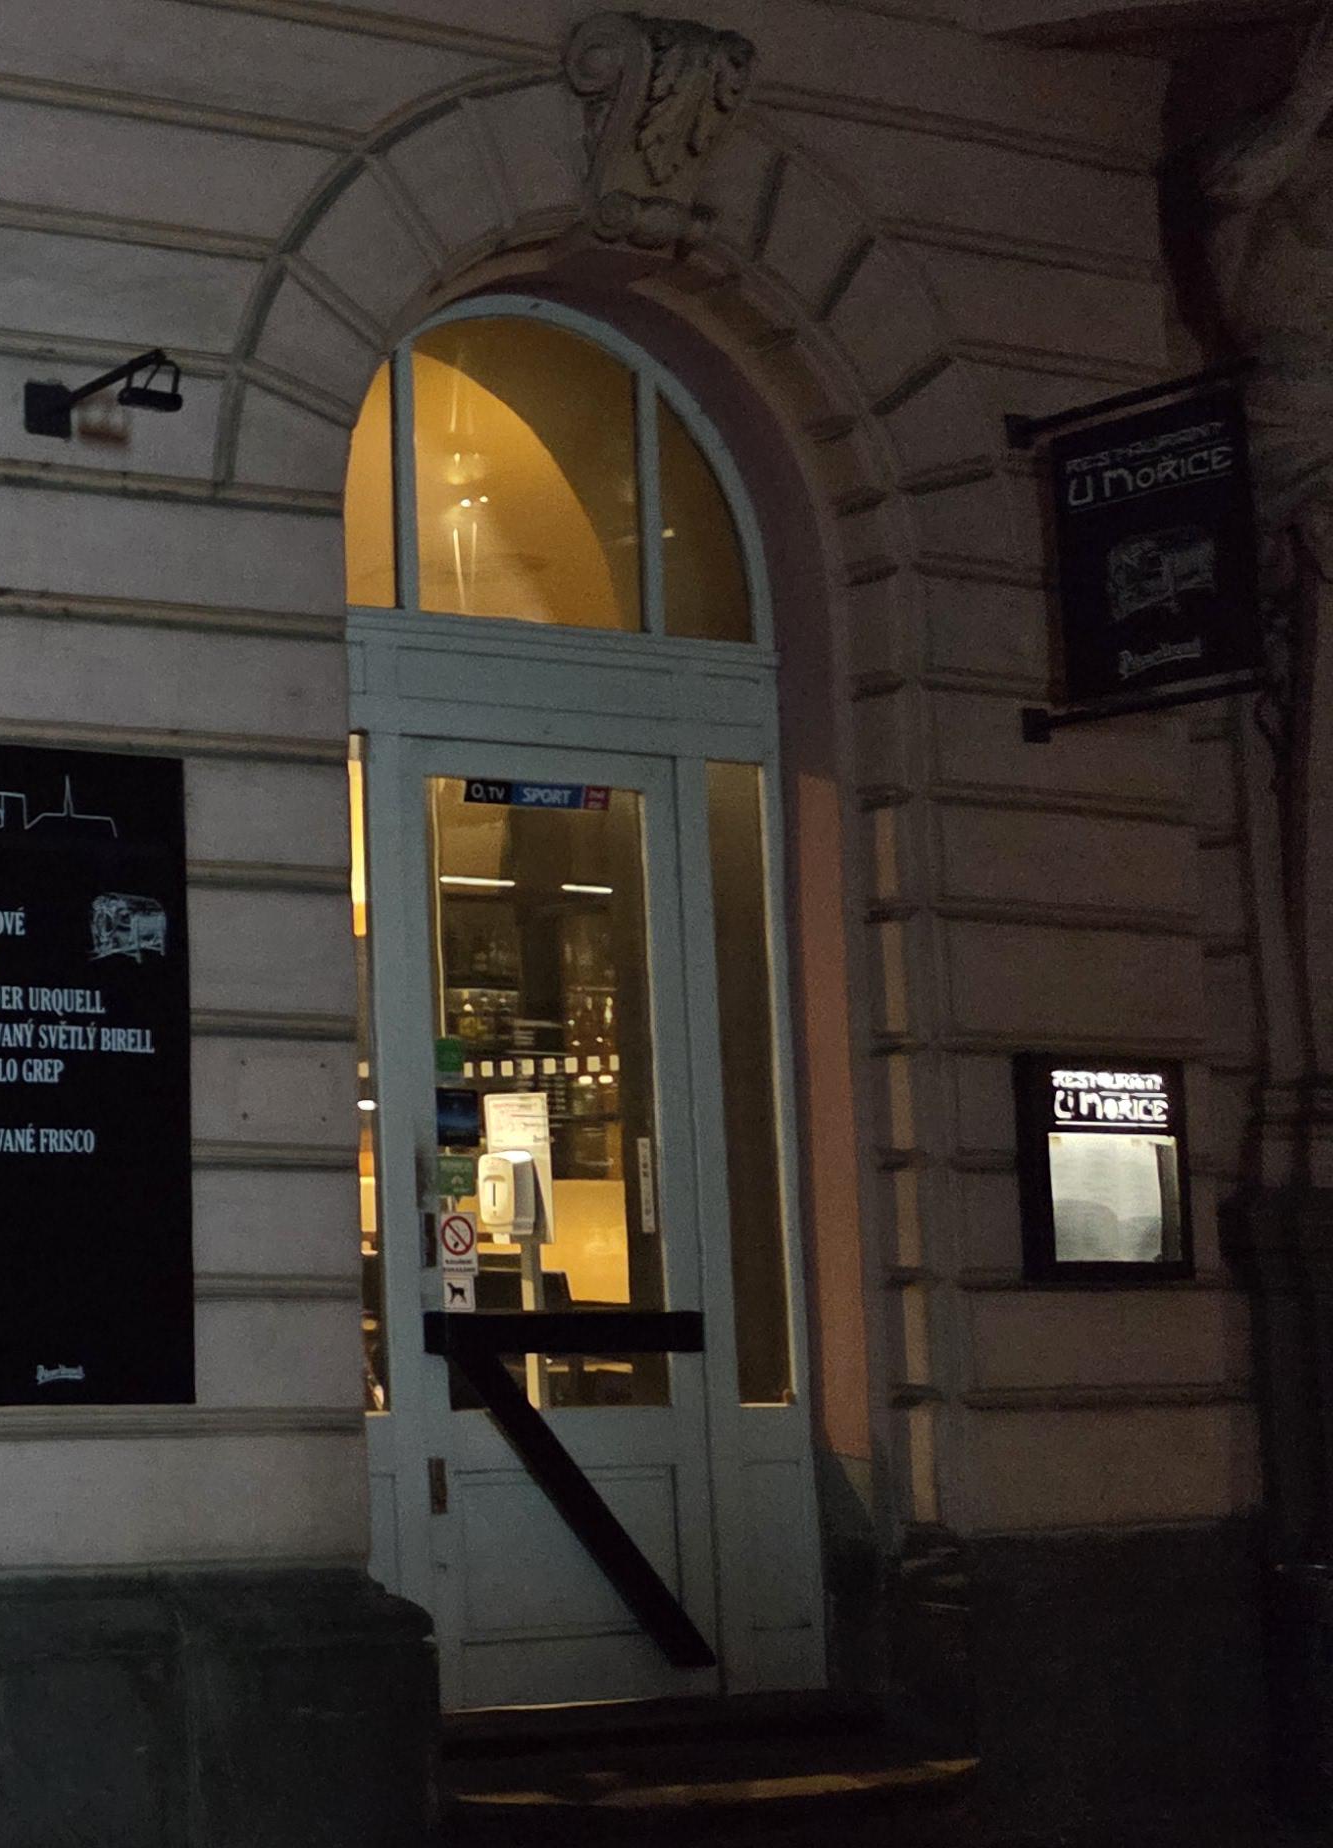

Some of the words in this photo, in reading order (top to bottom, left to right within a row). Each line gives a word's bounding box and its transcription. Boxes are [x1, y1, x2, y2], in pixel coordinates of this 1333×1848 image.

[1068, 475, 1094, 507] U
[1102, 446, 1233, 498] MOŘICE
[488, 786, 505, 800] TV
[522, 788, 572, 805] SPORT
[29, 988, 105, 1015] URQUELL
[38, 1021, 96, 1051] SVĚTLÝ
[101, 1028, 155, 1053] BIRELL
[22, 1060, 64, 1083] GREP
[40, 1130, 95, 1153] FRISCO
